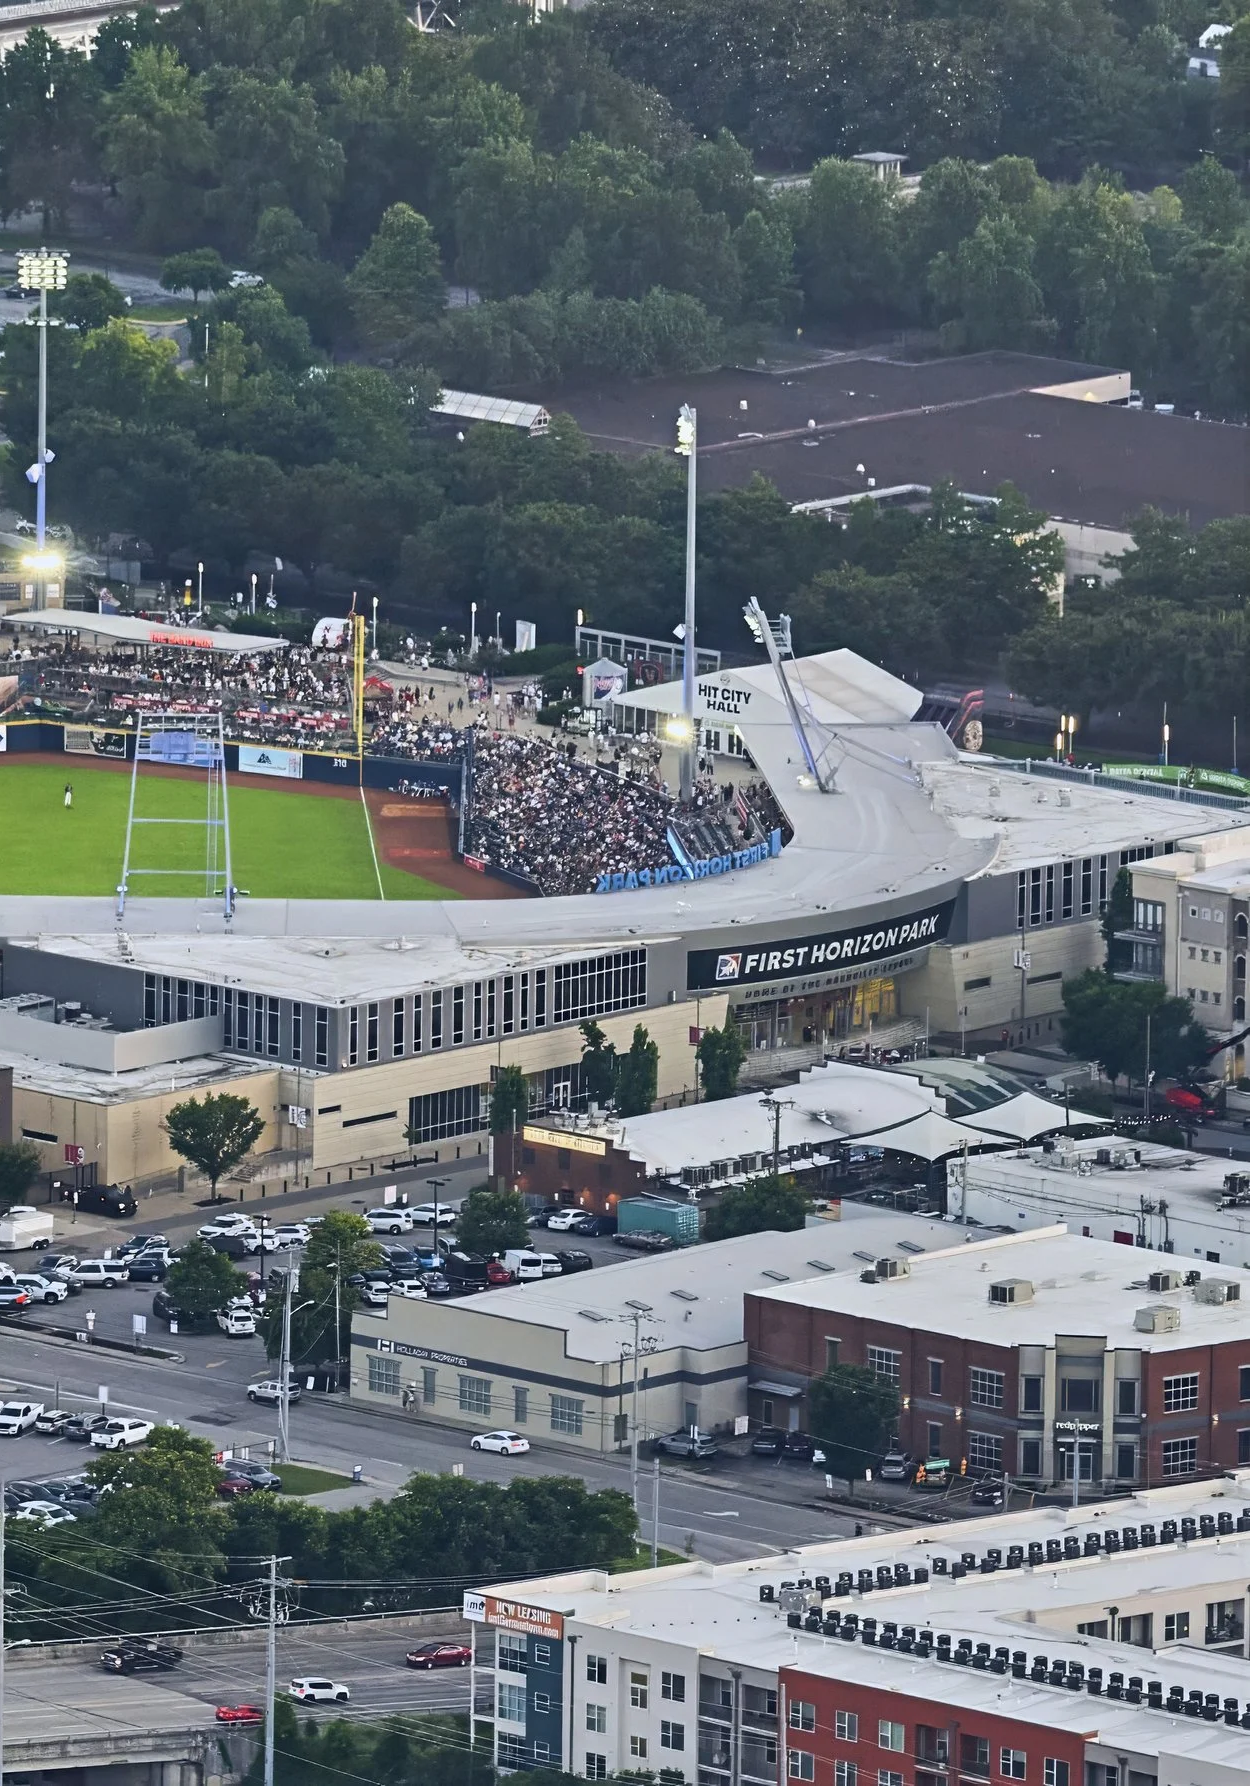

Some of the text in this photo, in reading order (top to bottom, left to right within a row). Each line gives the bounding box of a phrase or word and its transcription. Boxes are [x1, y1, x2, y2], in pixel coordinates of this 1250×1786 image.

[698, 683, 751, 704] HIT CITY
[707, 699, 740, 714] HALL
[744, 913, 939, 974] FIRST HORIZON PARK
[744, 987, 778, 999] HOME
[782, 985, 795, 994] OF
[801, 979, 821, 990] THE
[496, 1600, 515, 1617] NOW
[517, 1605, 551, 1624] LEASING
